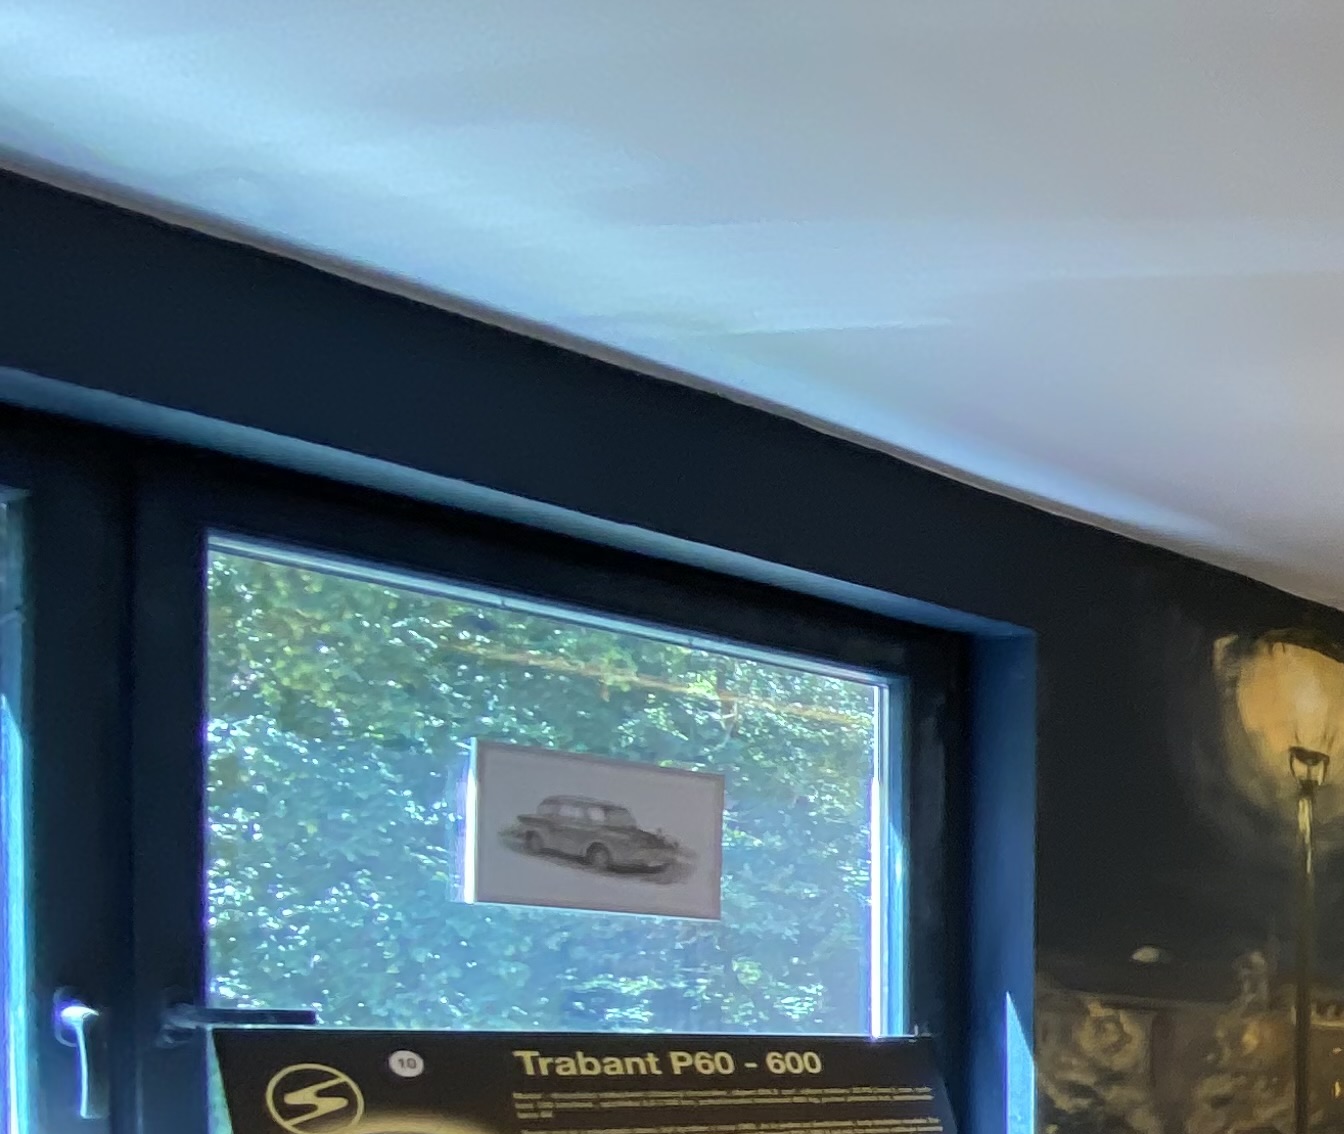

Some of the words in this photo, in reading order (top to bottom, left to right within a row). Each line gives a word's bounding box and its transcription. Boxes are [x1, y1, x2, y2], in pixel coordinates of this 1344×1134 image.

[512, 1050, 663, 1076] Trabant
[669, 1051, 736, 1075] P60
[765, 1050, 822, 1075] 600
